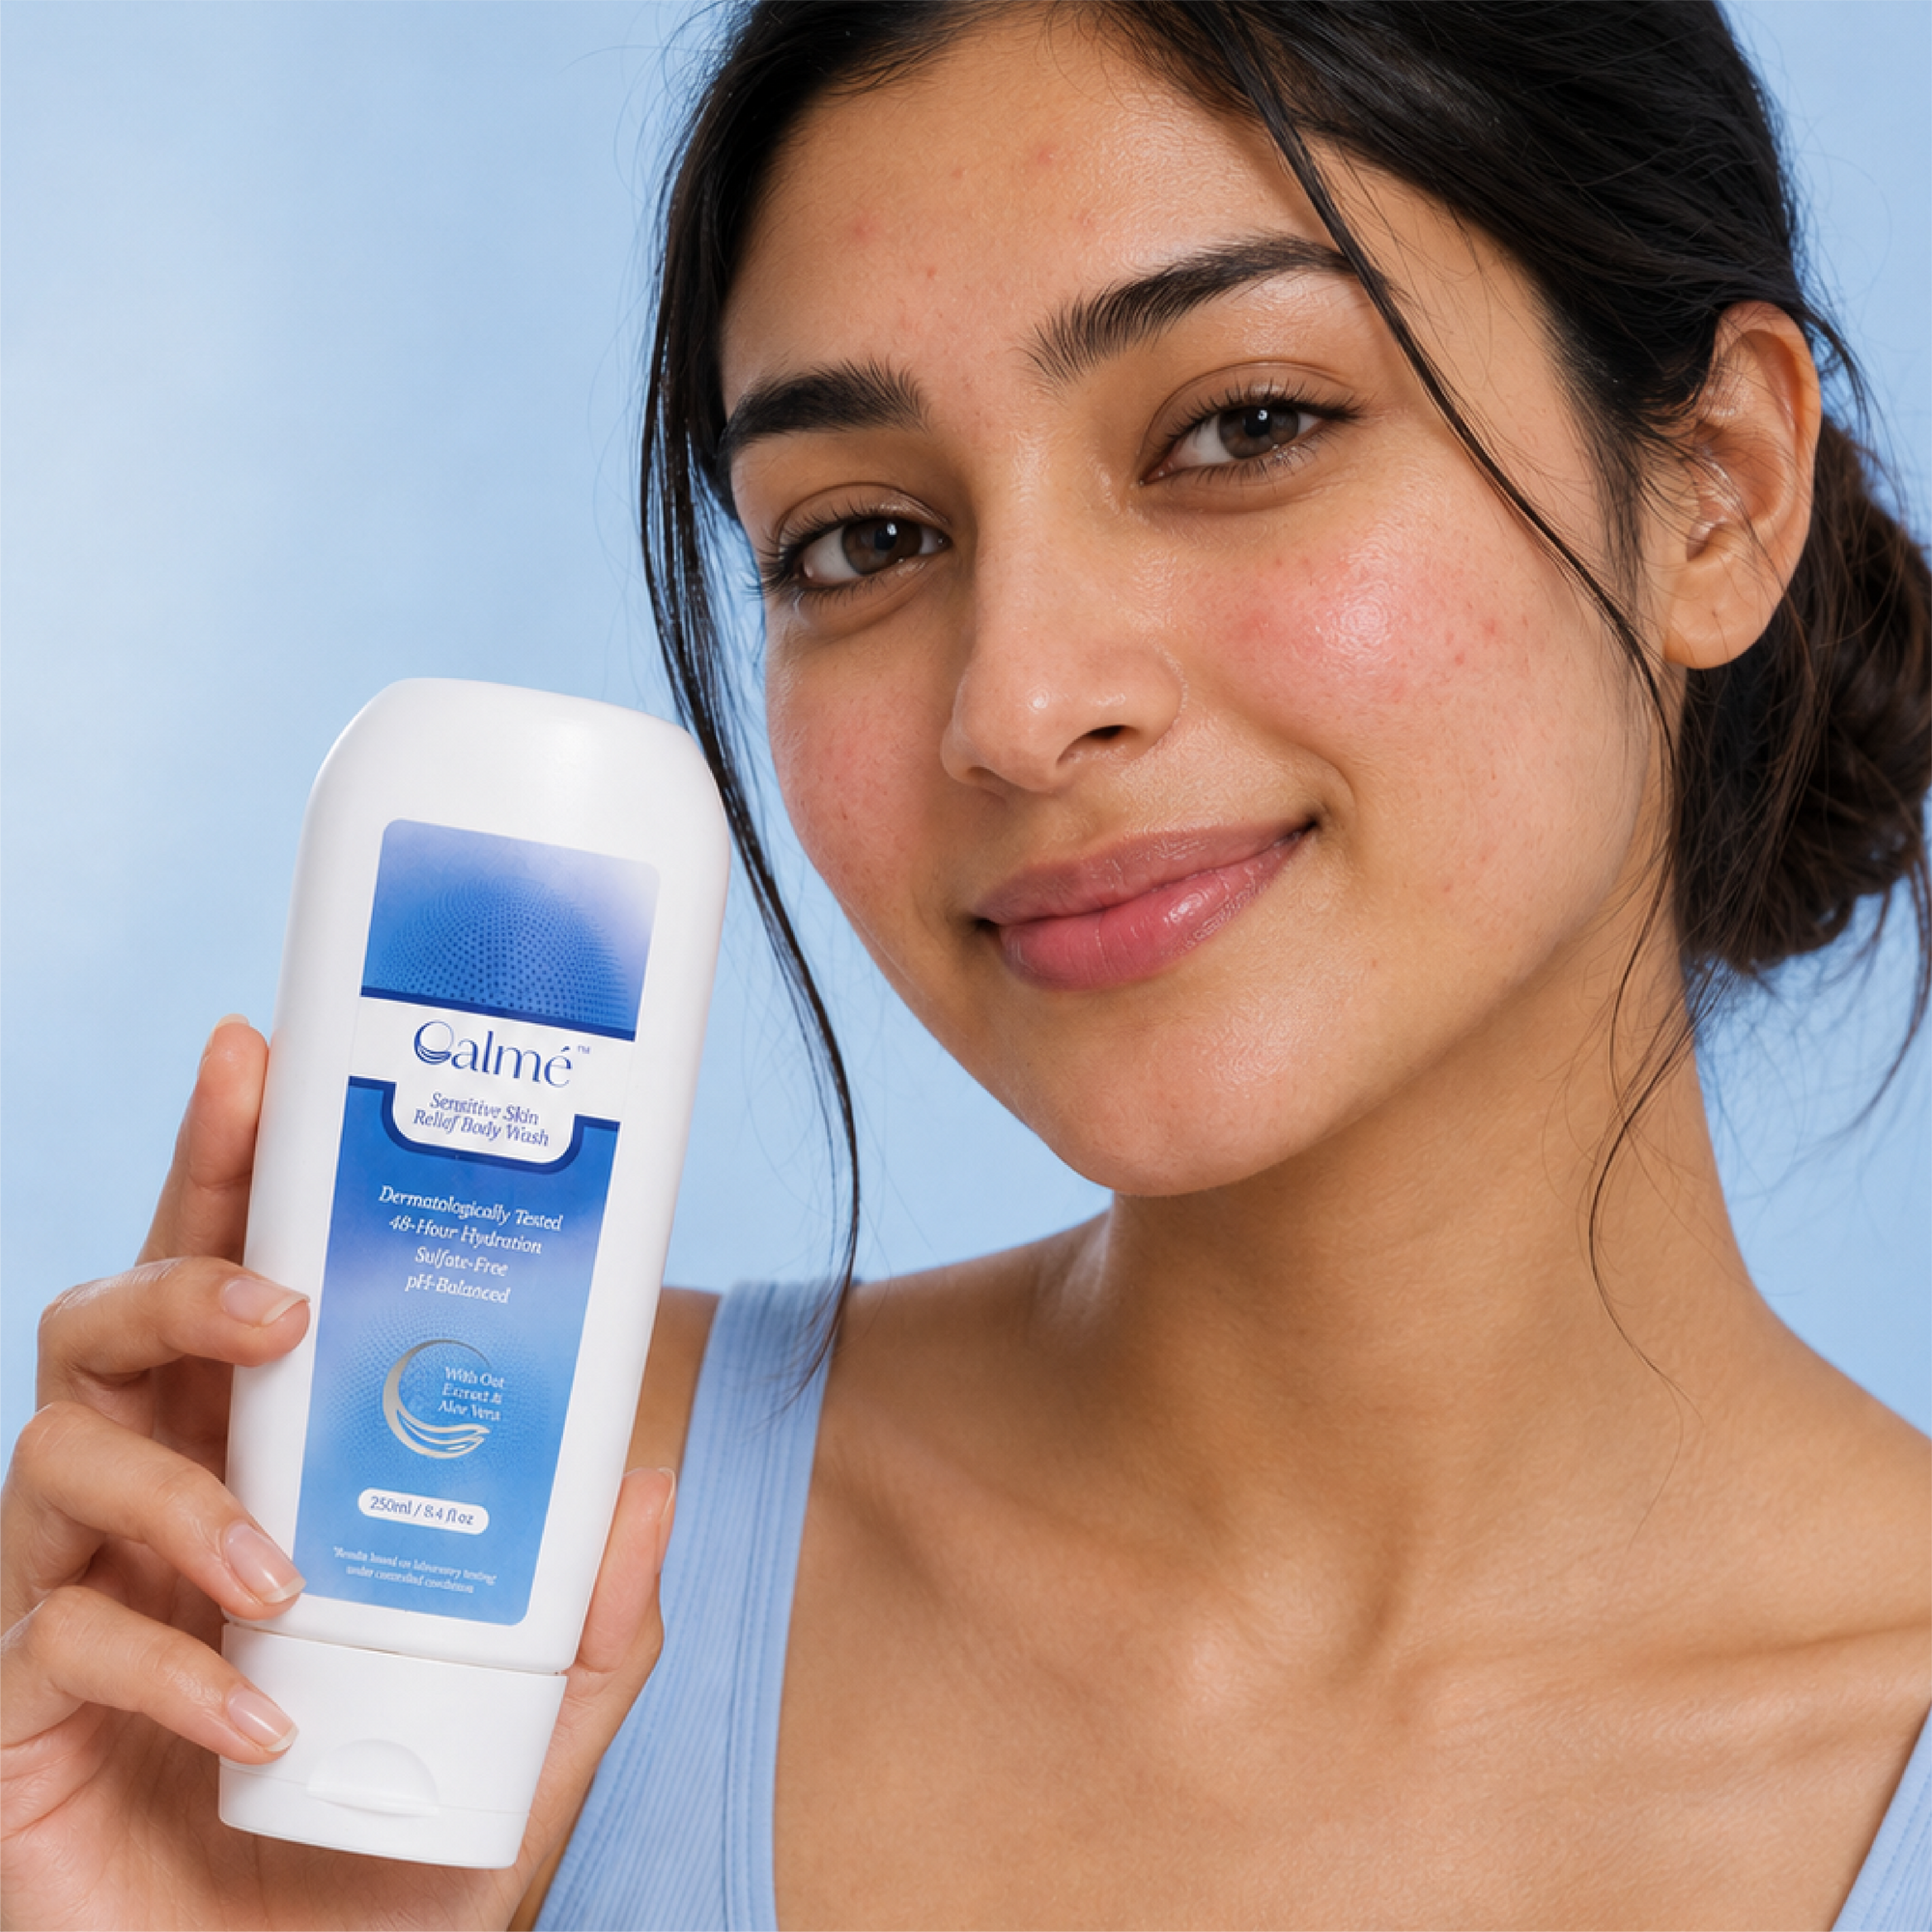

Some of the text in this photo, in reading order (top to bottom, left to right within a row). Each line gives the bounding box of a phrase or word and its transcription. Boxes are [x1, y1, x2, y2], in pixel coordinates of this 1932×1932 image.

[413, 1020, 573, 1088] Calmé
[430, 1092, 539, 1125] Sensitive Skin
[413, 1109, 549, 1147] Relief Body Wash
[378, 1185, 563, 1232] Dermatologically Tested
[389, 1215, 543, 1255] 48-Hour Hydration
[415, 1246, 508, 1277] Sulfate-Free
[405, 1273, 511, 1304] pH-Balanced
[445, 1366, 477, 1384] With
[370, 1495, 412, 1515] 250ml
